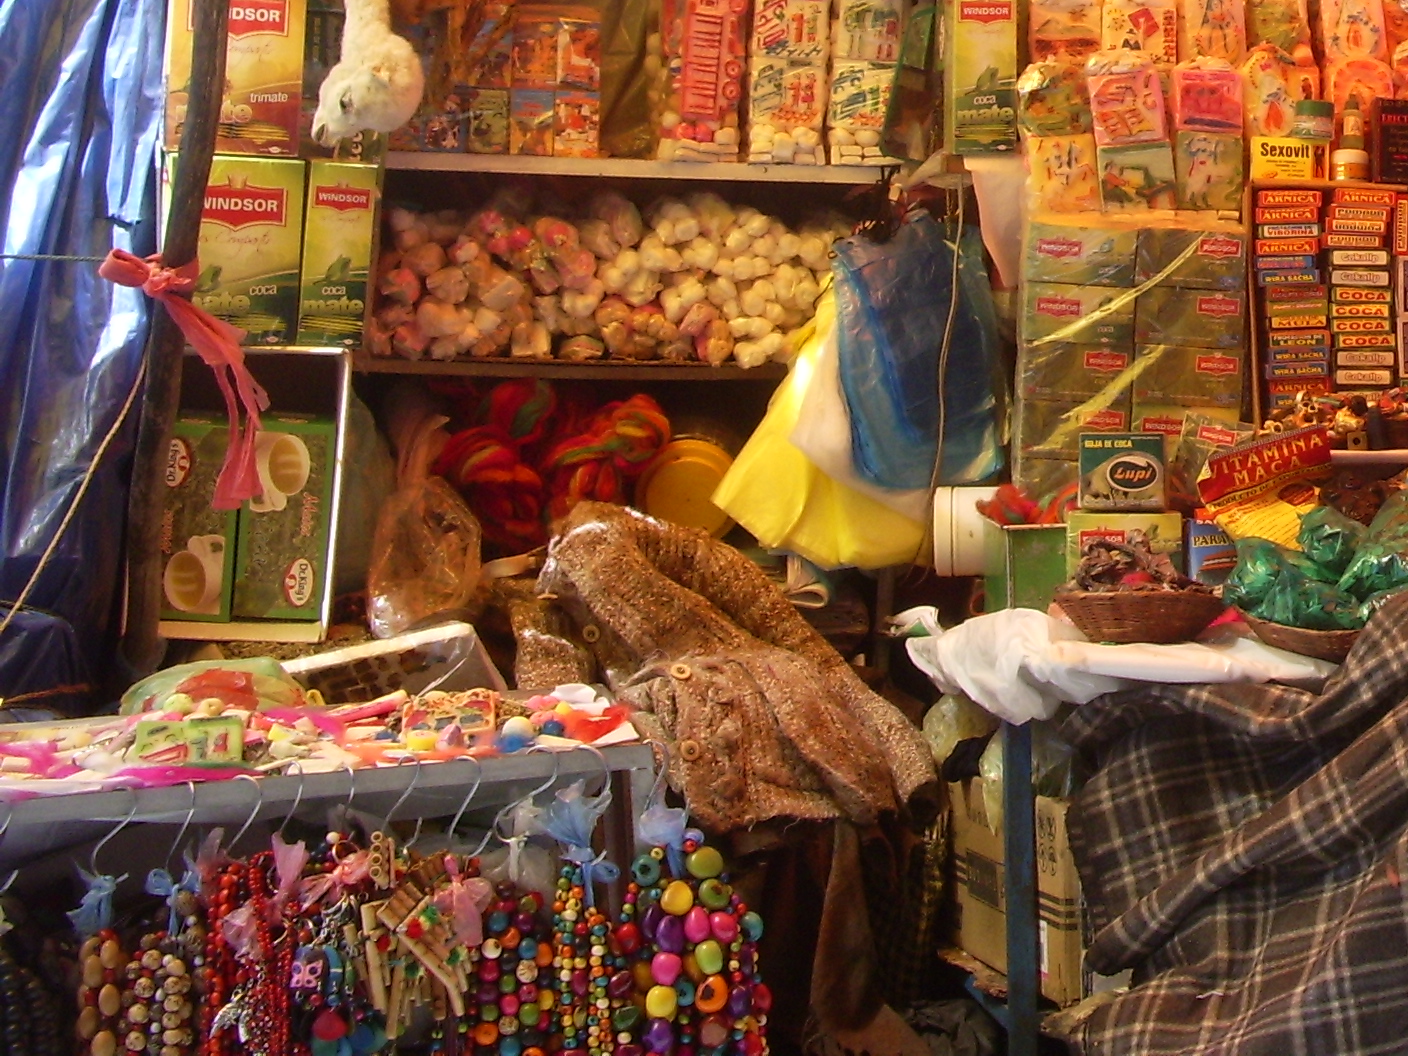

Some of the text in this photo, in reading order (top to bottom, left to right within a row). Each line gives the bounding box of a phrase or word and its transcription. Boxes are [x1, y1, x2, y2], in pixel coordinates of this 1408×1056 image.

[963, 6, 1010, 16] WINDSOR
[250, 91, 289, 103] trimate
[973, 95, 996, 105] coca
[957, 104, 1015, 125] mate
[1260, 142, 1310, 159] Sexovit
[318, 192, 368, 204] WINDSOR
[1265, 195, 1315, 204] ARNICA
[1340, 194, 1391, 204] ARNICA
[1262, 210, 1313, 220] ARNICA
[1260, 244, 1312, 254] ARNICA
[250, 285, 278, 295] coca
[321, 285, 347, 295] coca
[1338, 291, 1387, 301] COCA
[192, 291, 251, 312] ate
[302, 295, 364, 314] mate
[1335, 307, 1385, 316] COCA
[1335, 322, 1386, 331] COCA
[1279, 338, 1317, 346] LEON
[1341, 337, 1391, 346] COCA
[1273, 383, 1326, 392] ARNICA
[1210, 433, 1324, 479] VITAMINA
[1113, 466, 1153, 483] Lupi
[1233, 456, 1301, 486] MACA
